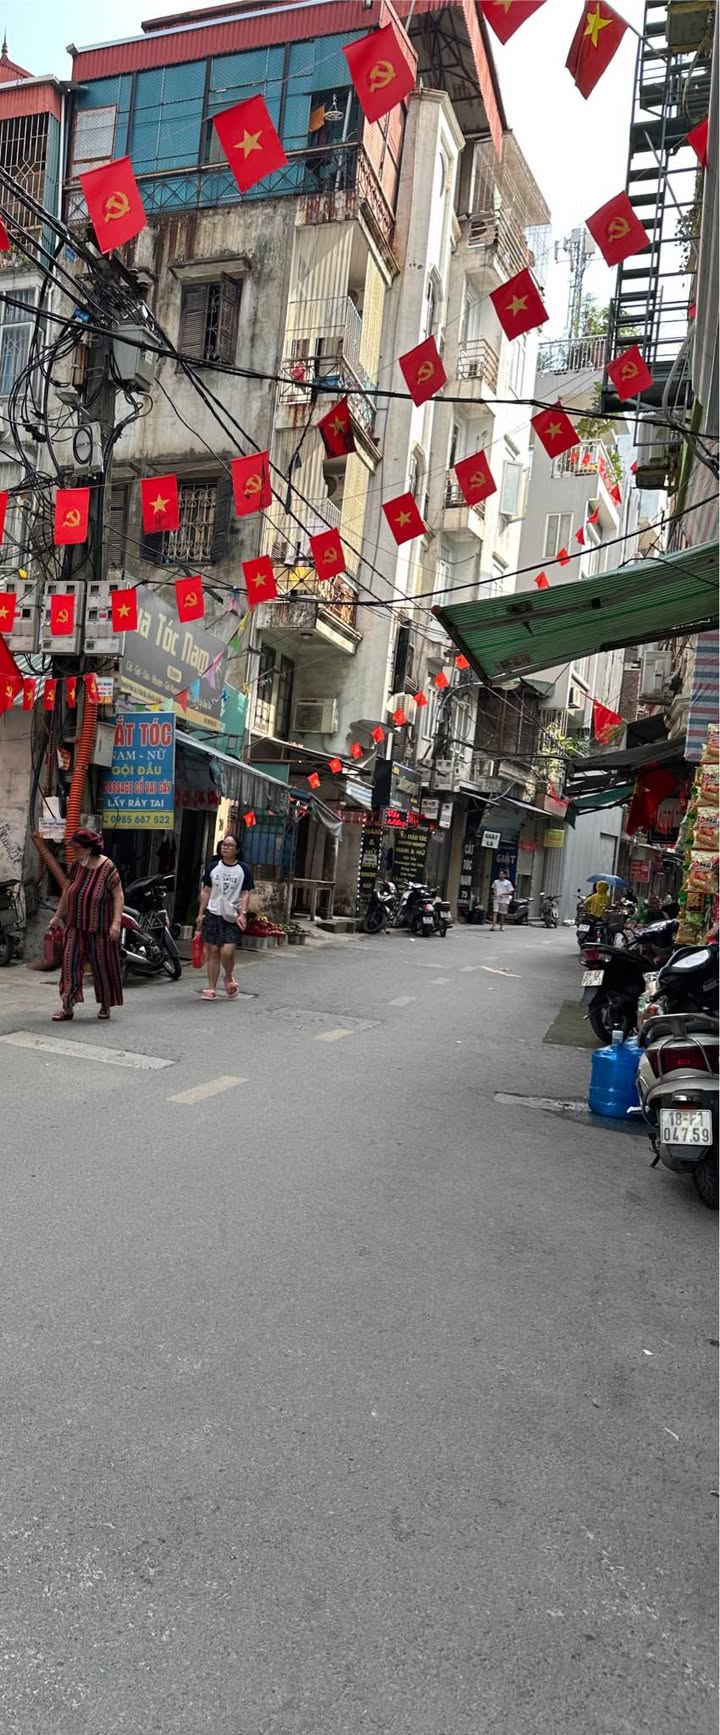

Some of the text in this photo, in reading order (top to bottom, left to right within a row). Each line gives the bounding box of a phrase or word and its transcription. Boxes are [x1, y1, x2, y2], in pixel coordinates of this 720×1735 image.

[156, 612, 179, 657] Tóc
[181, 631, 210, 676] Nam
[114, 715, 135, 747] ẮT
[147, 749, 166, 760] NỮ
[112, 764, 133, 777] GỘI
[108, 796, 125, 807] LẤY
[150, 799, 164, 807] TAI
[111, 816, 169, 824] 0985 687 522
[669, 1111, 704, 1127] 18-F1
[663, 1127, 710, 1143] 047.59
